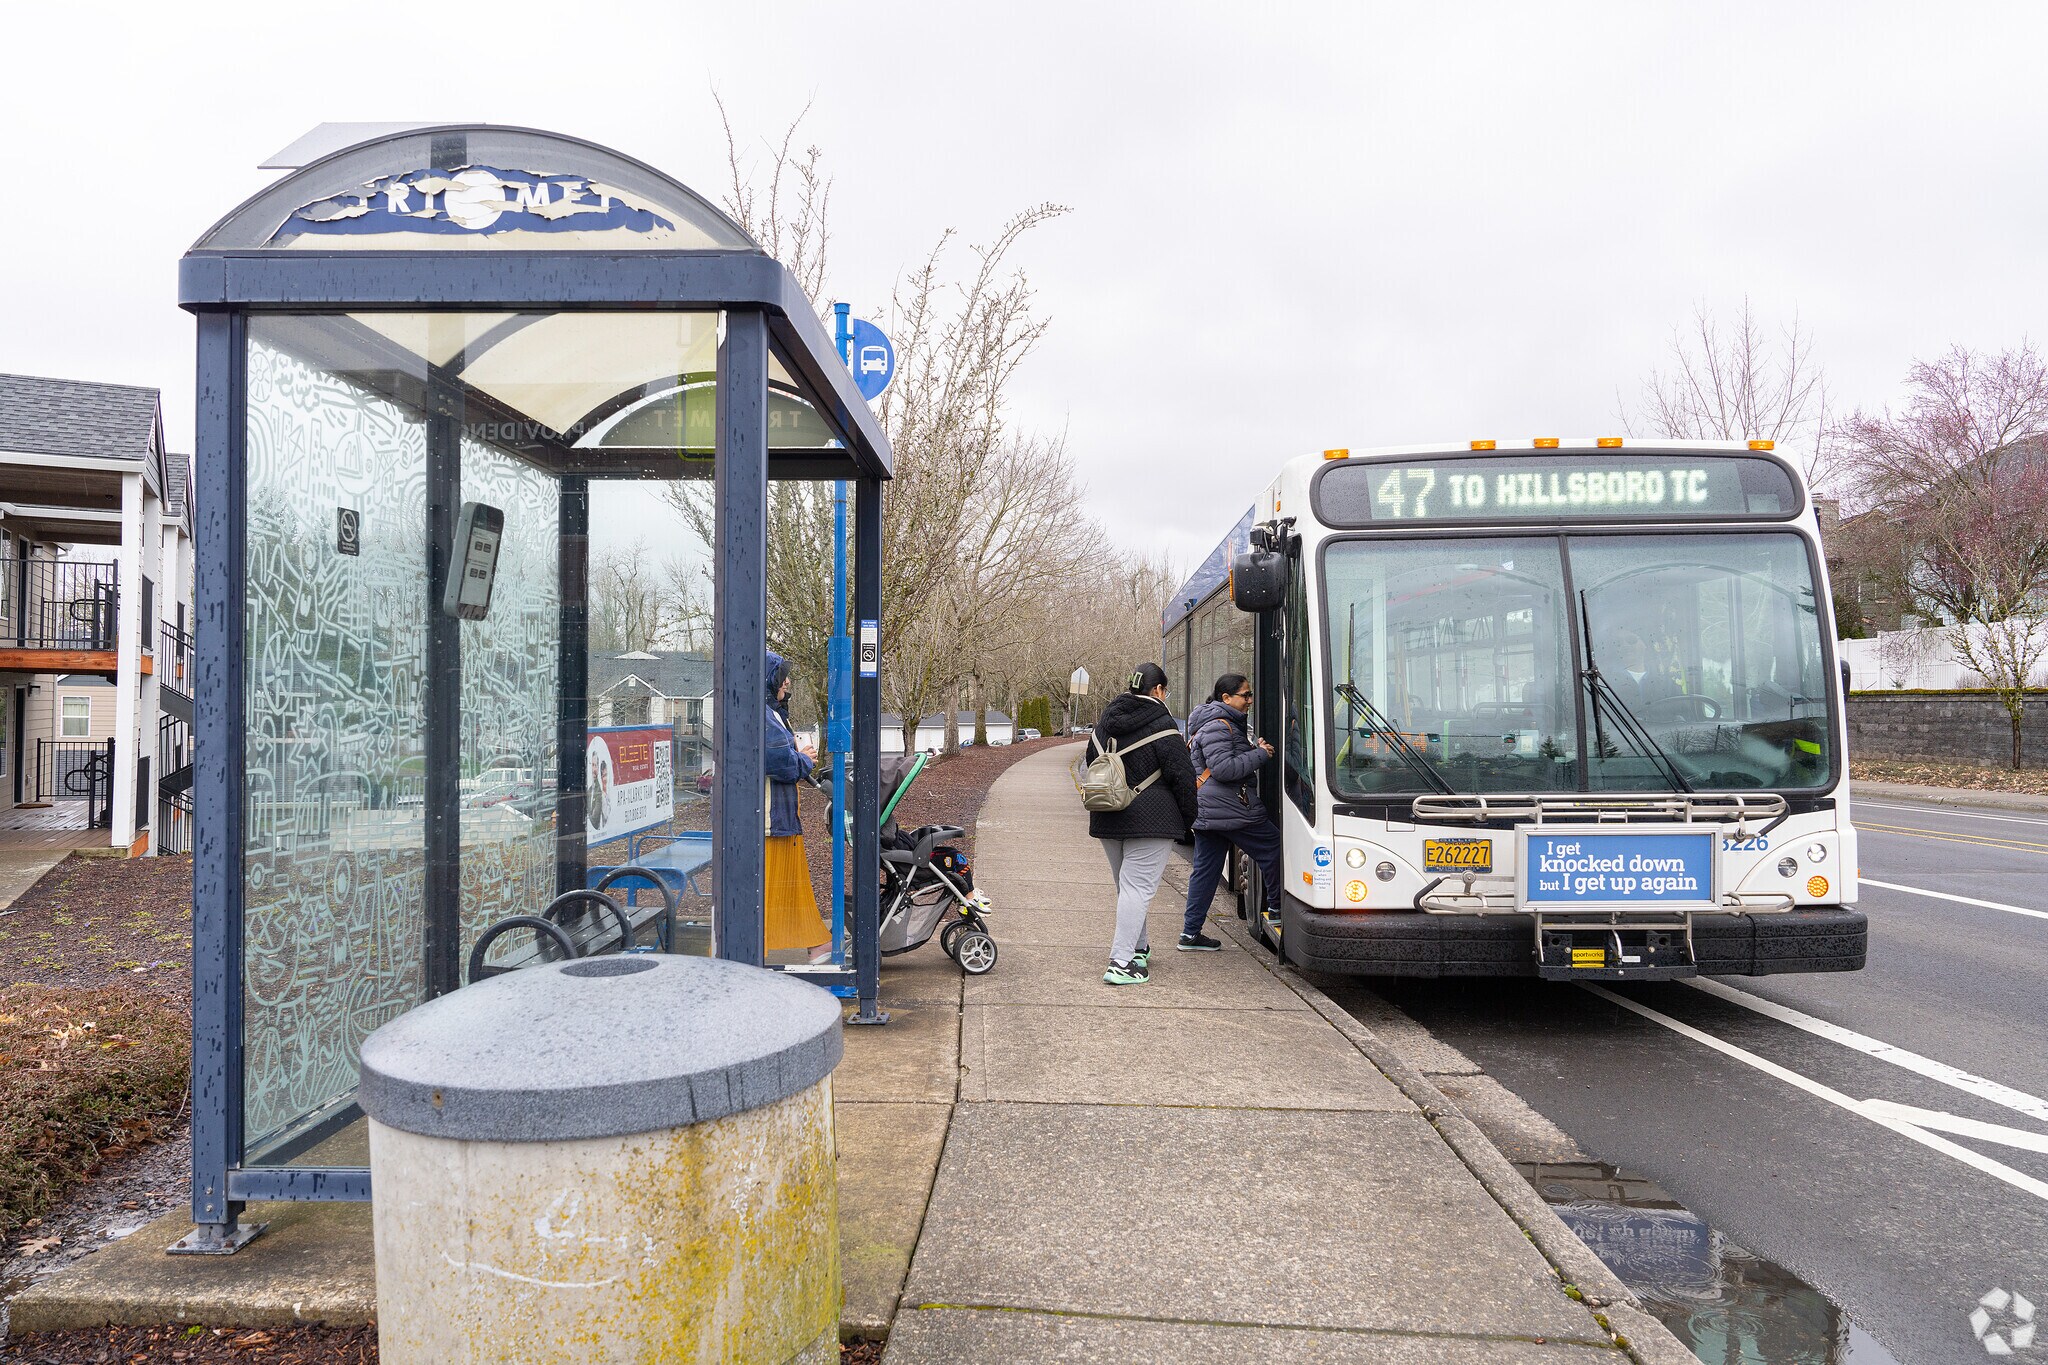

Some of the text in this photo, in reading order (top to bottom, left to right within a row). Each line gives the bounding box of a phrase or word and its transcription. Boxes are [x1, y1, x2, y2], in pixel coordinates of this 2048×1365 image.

[1377, 468, 1708, 517] 47 TO HILLSBORO TC
[1427, 846, 1489, 864] E262227
[1547, 841, 1581, 859] I get
[1540, 854, 1685, 873] knocked down
[1540, 873, 1698, 895] but I get up again
